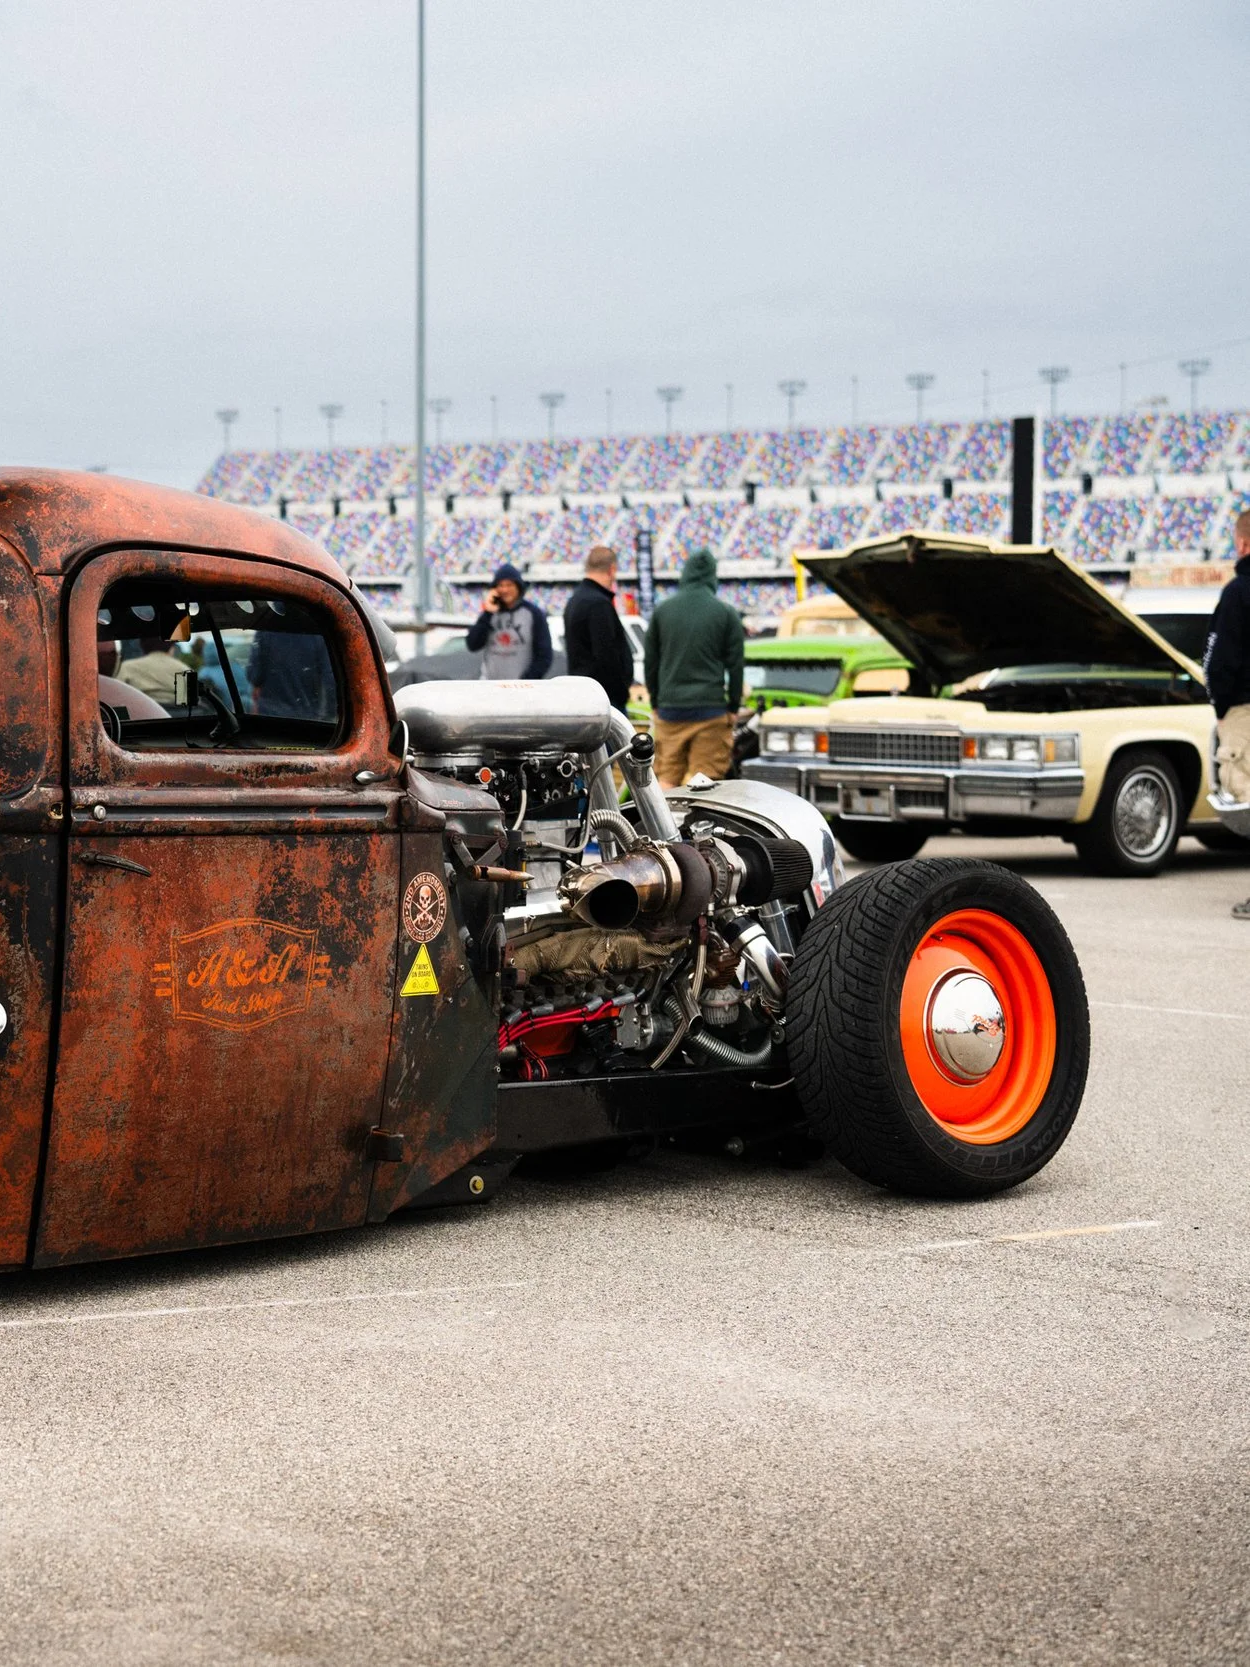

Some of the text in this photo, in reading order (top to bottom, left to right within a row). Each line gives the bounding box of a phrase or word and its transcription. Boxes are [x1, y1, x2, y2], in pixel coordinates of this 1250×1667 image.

[404, 874, 445, 909] 2ND AMENDMENT
[187, 943, 301, 988] A&A
[242, 991, 285, 1015] Shop
